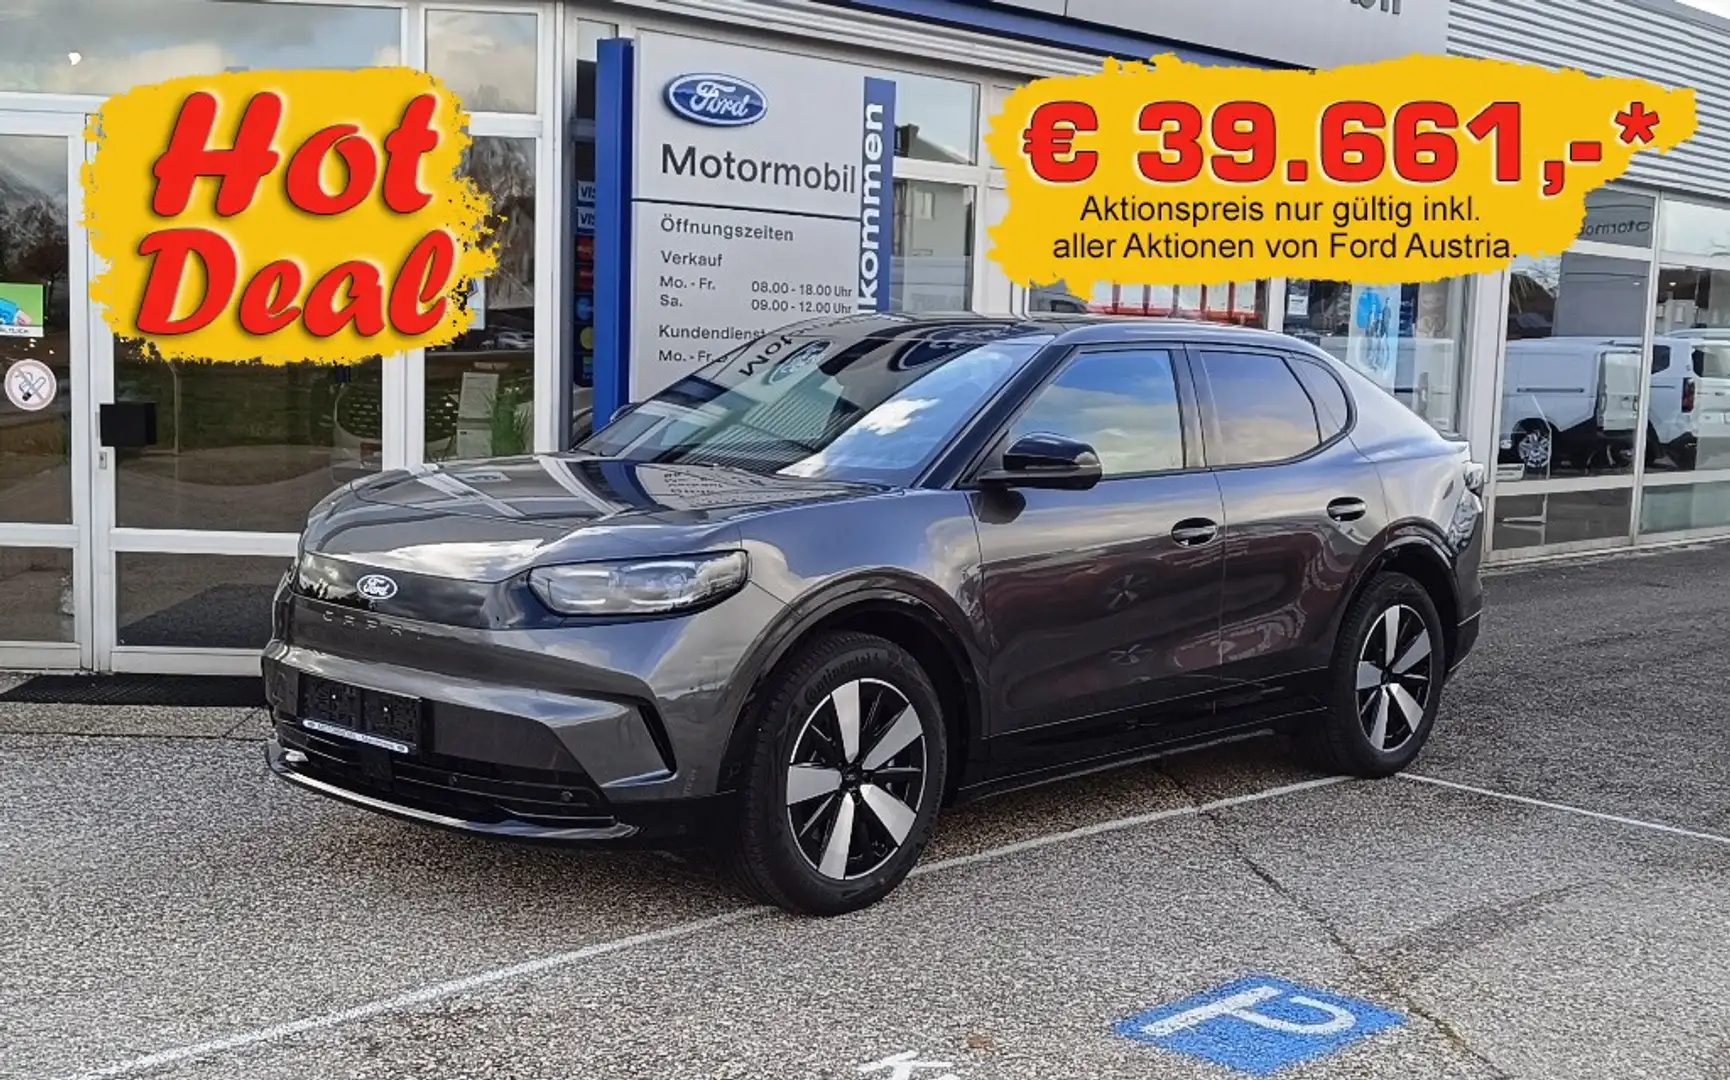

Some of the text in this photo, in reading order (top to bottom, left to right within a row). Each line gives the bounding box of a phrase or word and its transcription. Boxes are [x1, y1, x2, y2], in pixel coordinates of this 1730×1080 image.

[690, 81, 751, 117] Ford
[662, 143, 856, 194] Motormobil
[660, 213, 794, 241] Öffnungszeiten
[660, 250, 723, 267] Verkauf
[659, 275, 687, 289] Mo.
[699, 277, 716, 290] Fr.
[751, 280, 789, 294] 08.00
[799, 283, 832, 297] 18.00
[834, 285, 853, 297] Uhr
[660, 294, 683, 308] Sa.
[751, 299, 789, 312] 09.00
[799, 301, 831, 314] 12.00
[833, 303, 852, 314] Uhr
[658, 325, 766, 341] Kundendienst
[658, 349, 687, 362] Mo.
[362, 577, 389, 596] Ford
